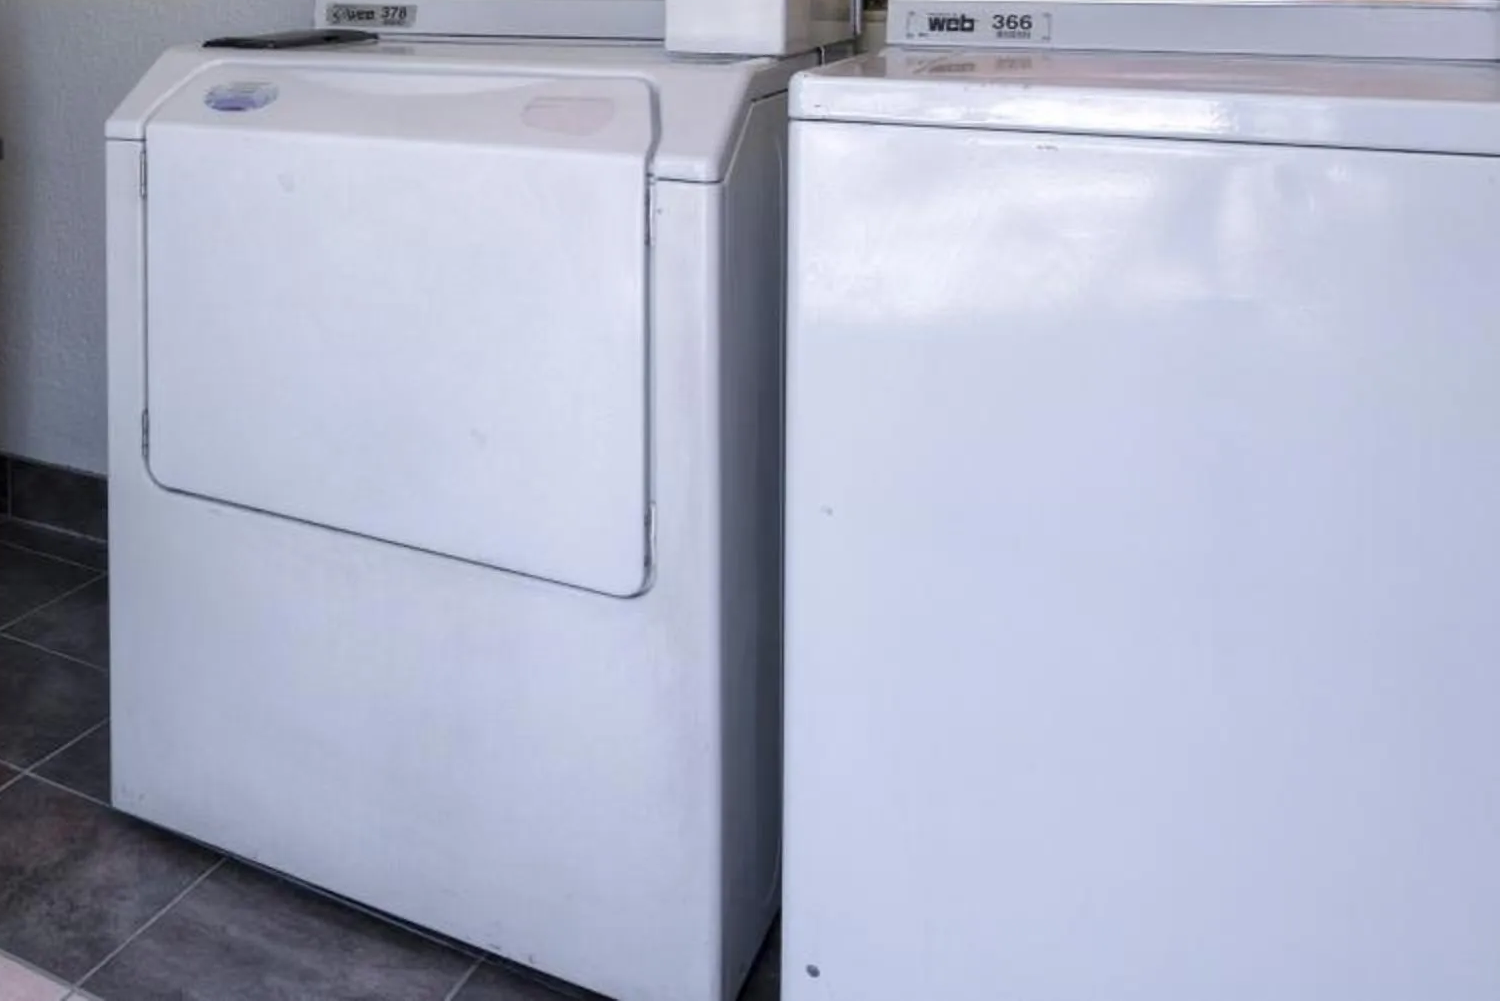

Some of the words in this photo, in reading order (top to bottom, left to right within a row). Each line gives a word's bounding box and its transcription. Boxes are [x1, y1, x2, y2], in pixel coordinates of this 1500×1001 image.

[381, 6, 407, 19] 378
[928, 14, 975, 32] web
[992, 14, 1033, 30] 366
